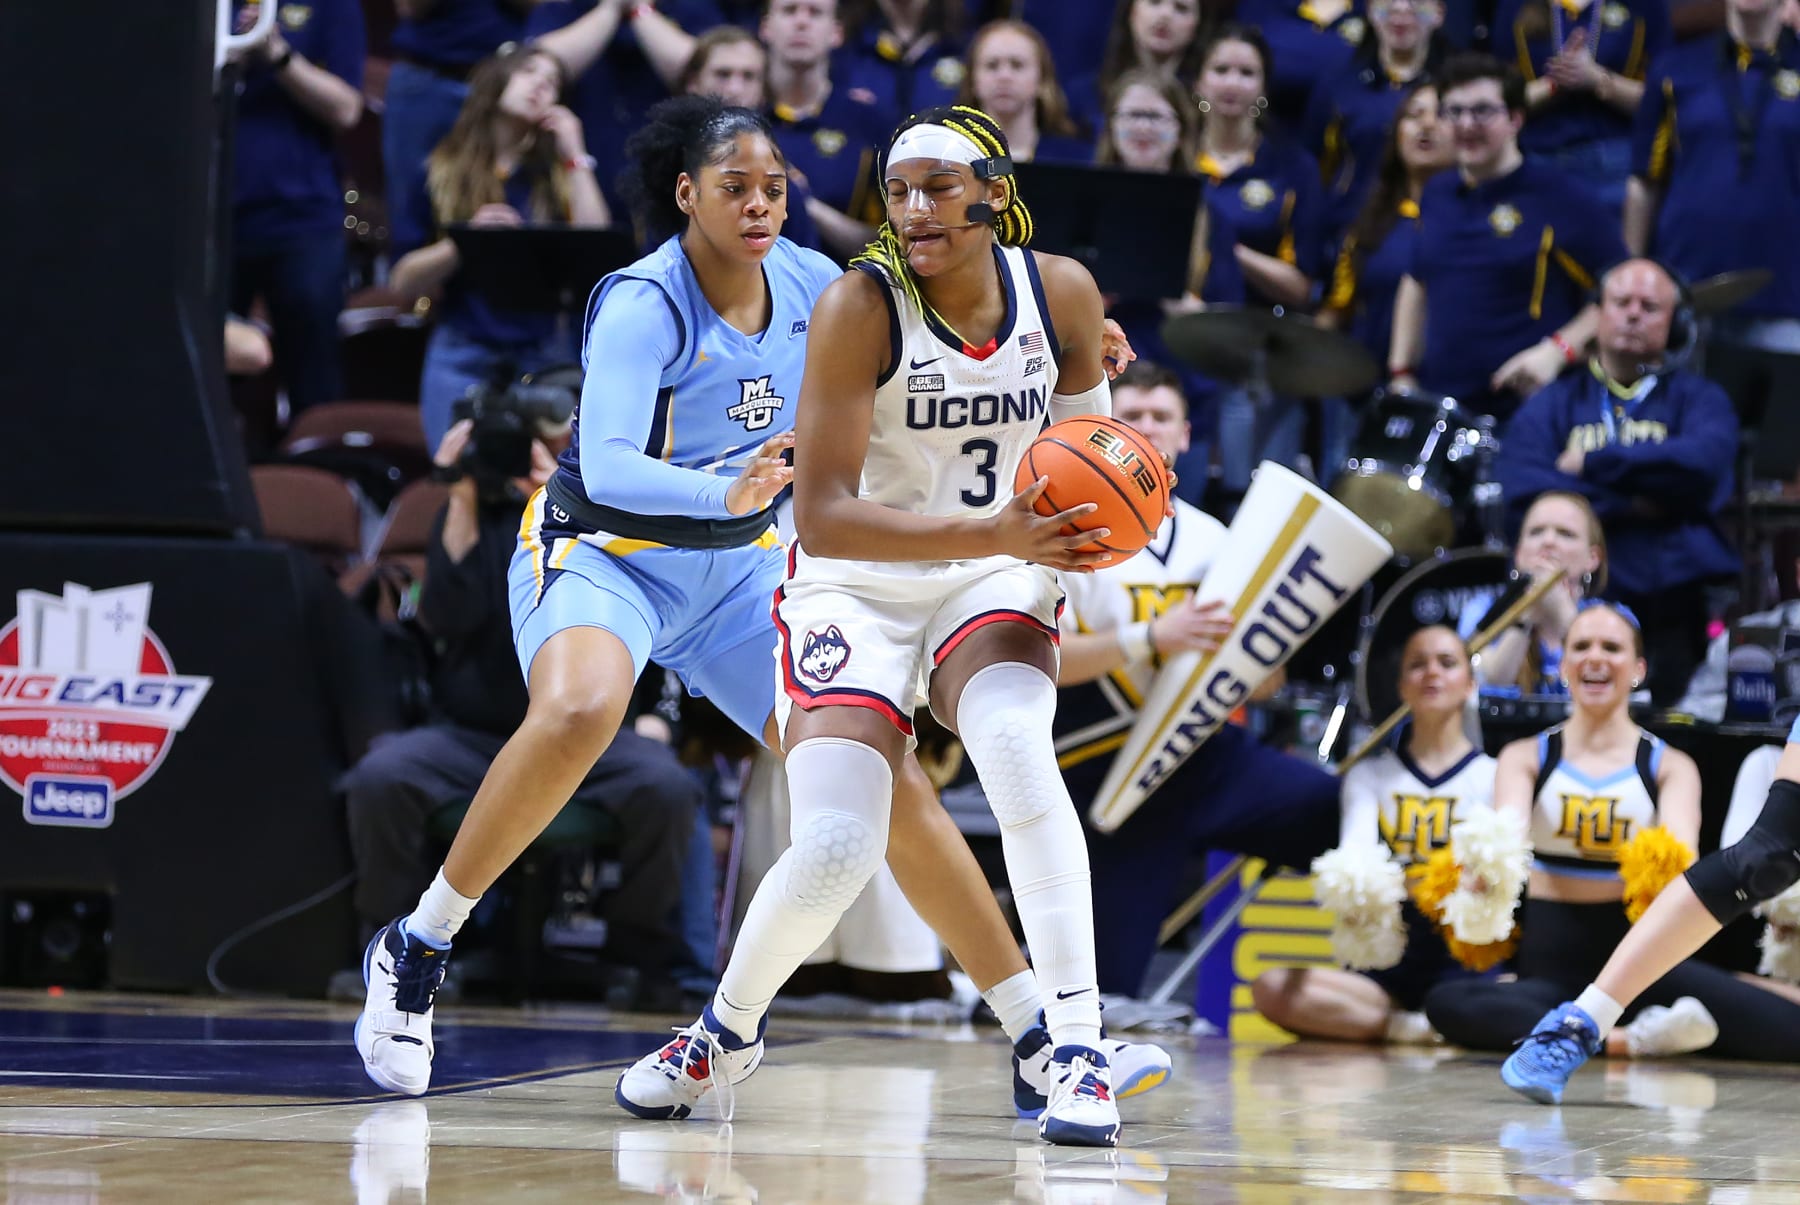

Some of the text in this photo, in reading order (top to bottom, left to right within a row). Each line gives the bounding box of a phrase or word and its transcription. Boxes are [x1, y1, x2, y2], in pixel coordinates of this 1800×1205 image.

[1024, 361, 1048, 374] EAST
[1025, 356, 1043, 366] BIG
[909, 383, 944, 391] CHANGE
[731, 399, 781, 415] MARQUETTE
[906, 384, 1047, 430] UCONN
[960, 436, 999, 507] 3
[1135, 544, 1348, 792] RING OUT
[0, 676, 195, 708] IG EAST
[0, 734, 157, 764] OURNAMENT
[33, 783, 106, 819] Jeep
[1553, 794, 1633, 861] MU
